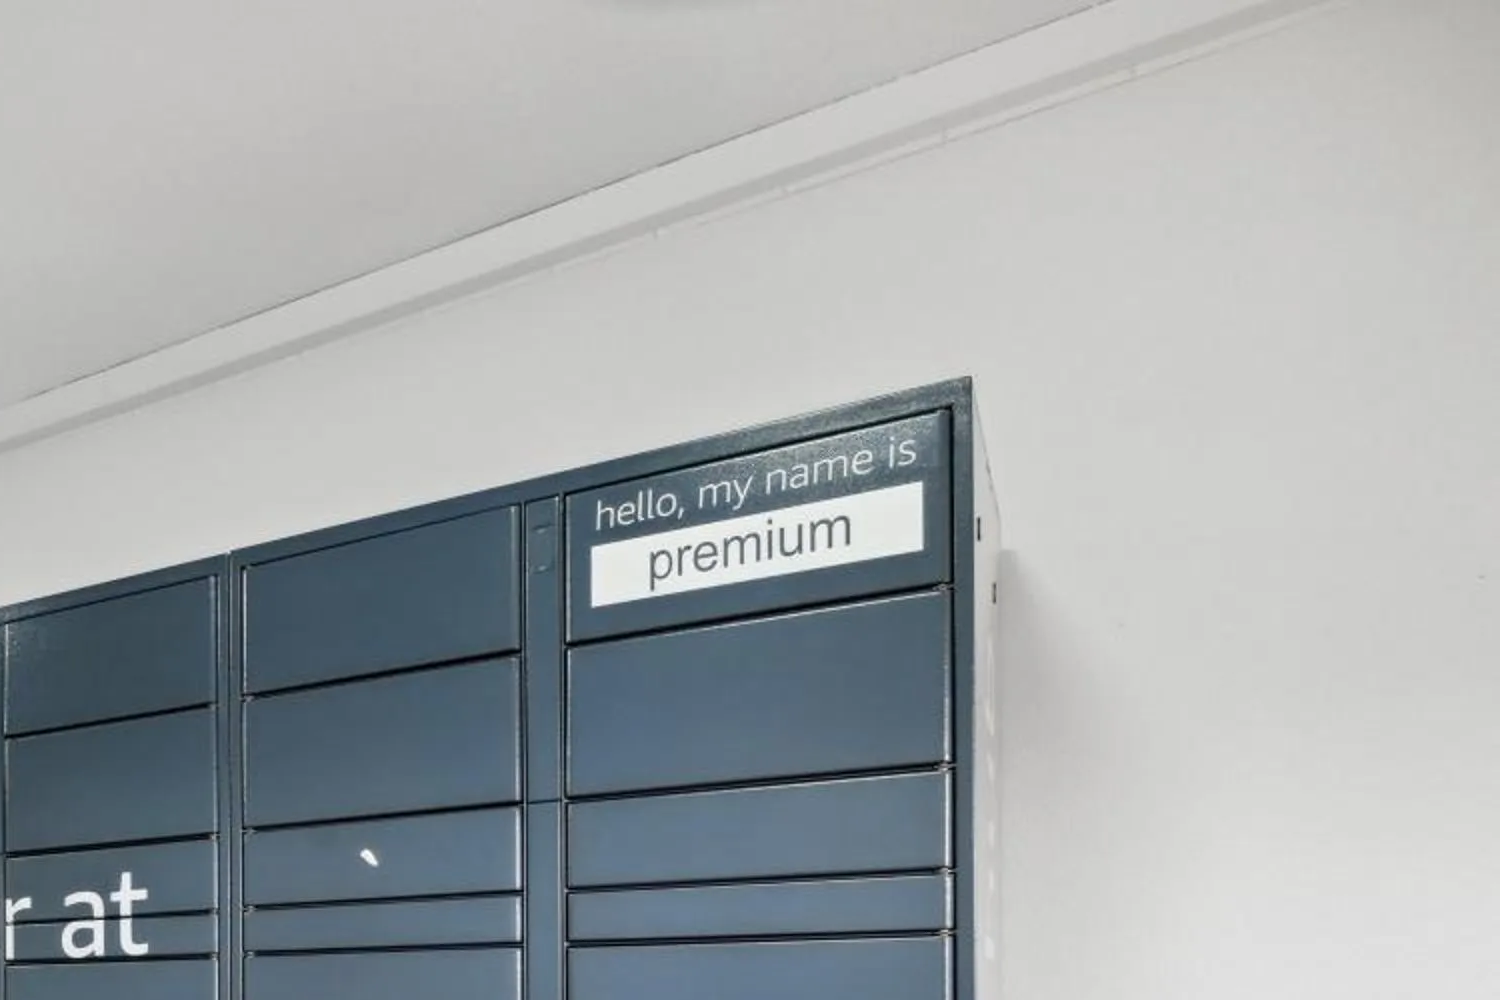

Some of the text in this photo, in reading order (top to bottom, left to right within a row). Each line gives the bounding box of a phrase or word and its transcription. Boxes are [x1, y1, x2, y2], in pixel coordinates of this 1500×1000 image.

[595, 436, 917, 531] hello, my name is
[649, 514, 851, 590] premium
[60, 871, 149, 961] at
